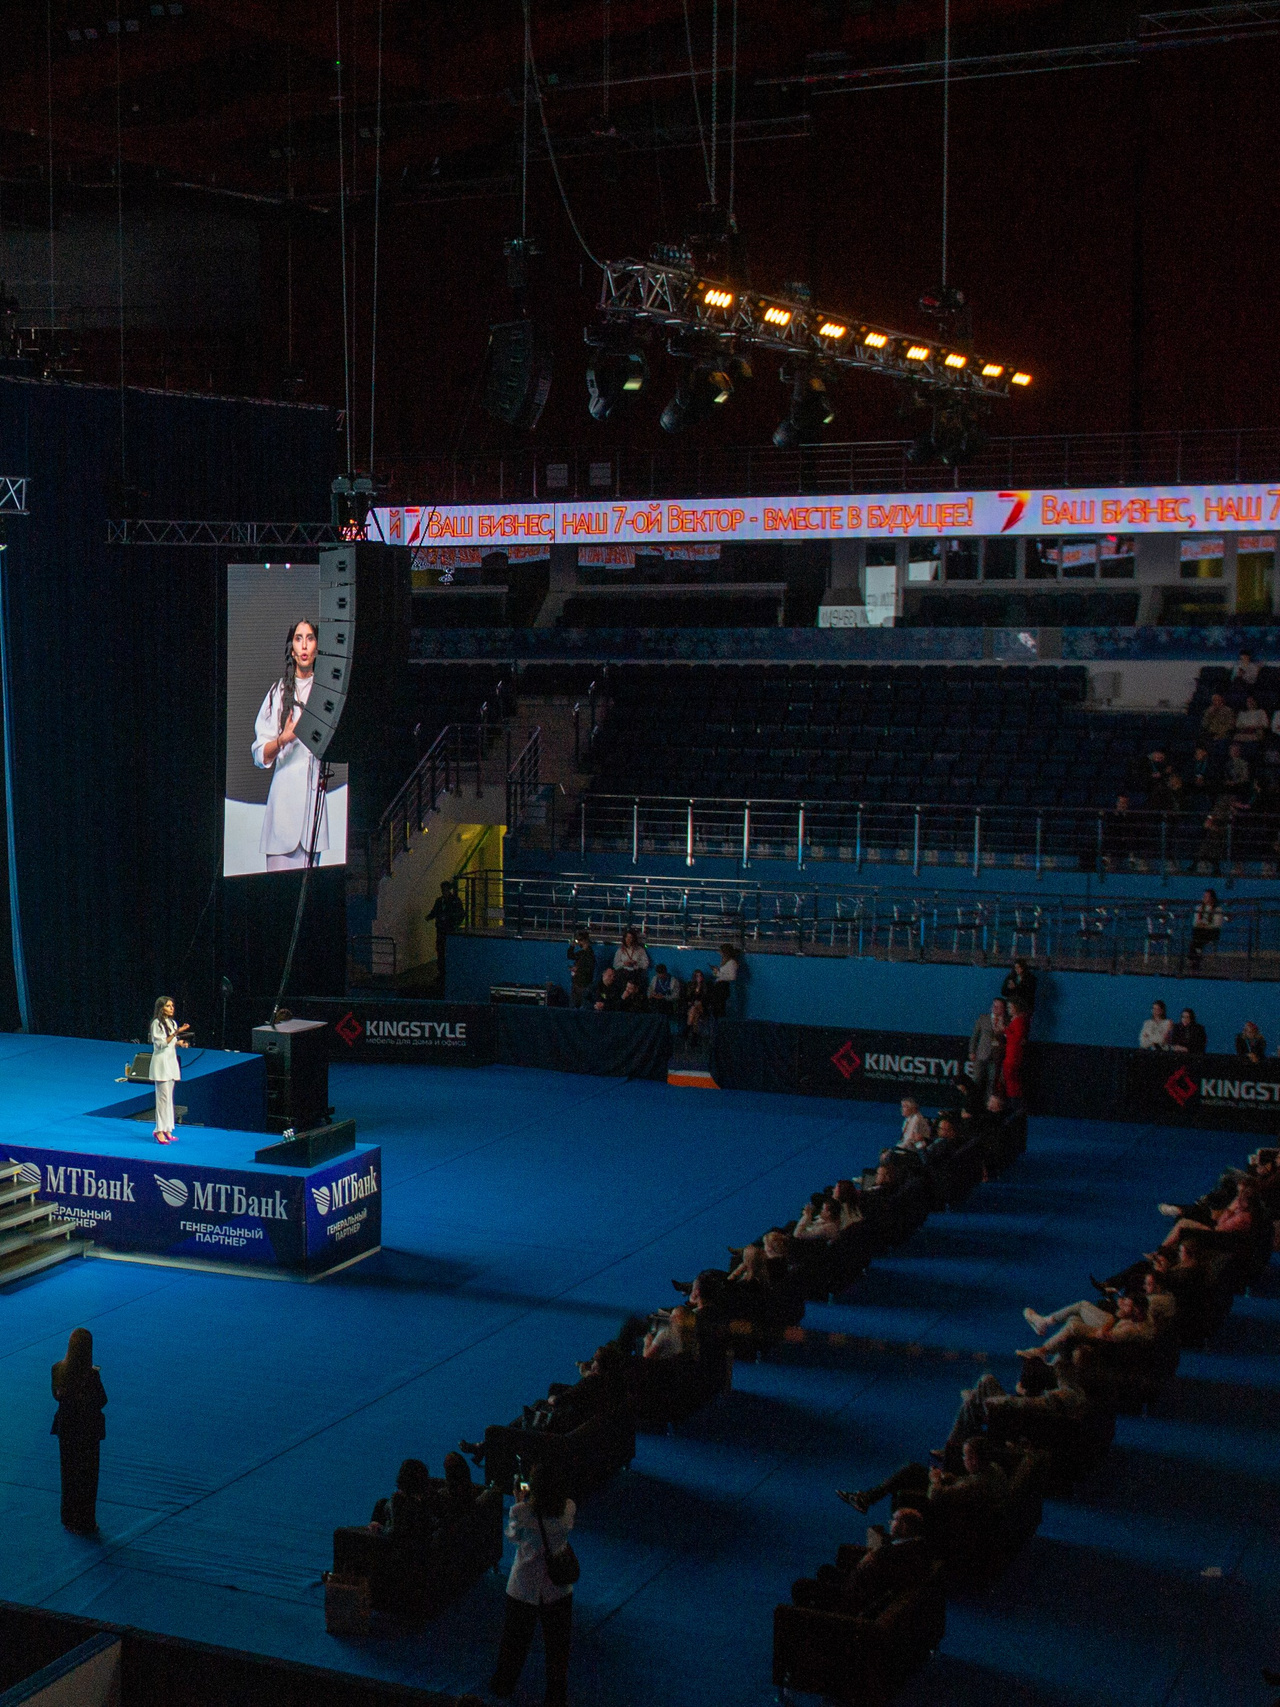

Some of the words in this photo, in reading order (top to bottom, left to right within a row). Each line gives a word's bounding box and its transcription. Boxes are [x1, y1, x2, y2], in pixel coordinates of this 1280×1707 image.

[365, 1020, 467, 1039] KINGSTYLE
[45, 1164, 136, 1203] МТБанк
[331, 1165, 378, 1211] МТБанк
[192, 1181, 288, 1220] МТБанк
[53, 1206, 112, 1221] ЕРАЛЬНЫЙ
[326, 1207, 368, 1236] ГЕНЕРАЛЬНЫЙ
[180, 1220, 263, 1240] ГЕНЕРАЛЬНЫЙ
[195, 1232, 247, 1247] ПАРТНЕР
[335, 1222, 361, 1242] ПАРТНЕР
